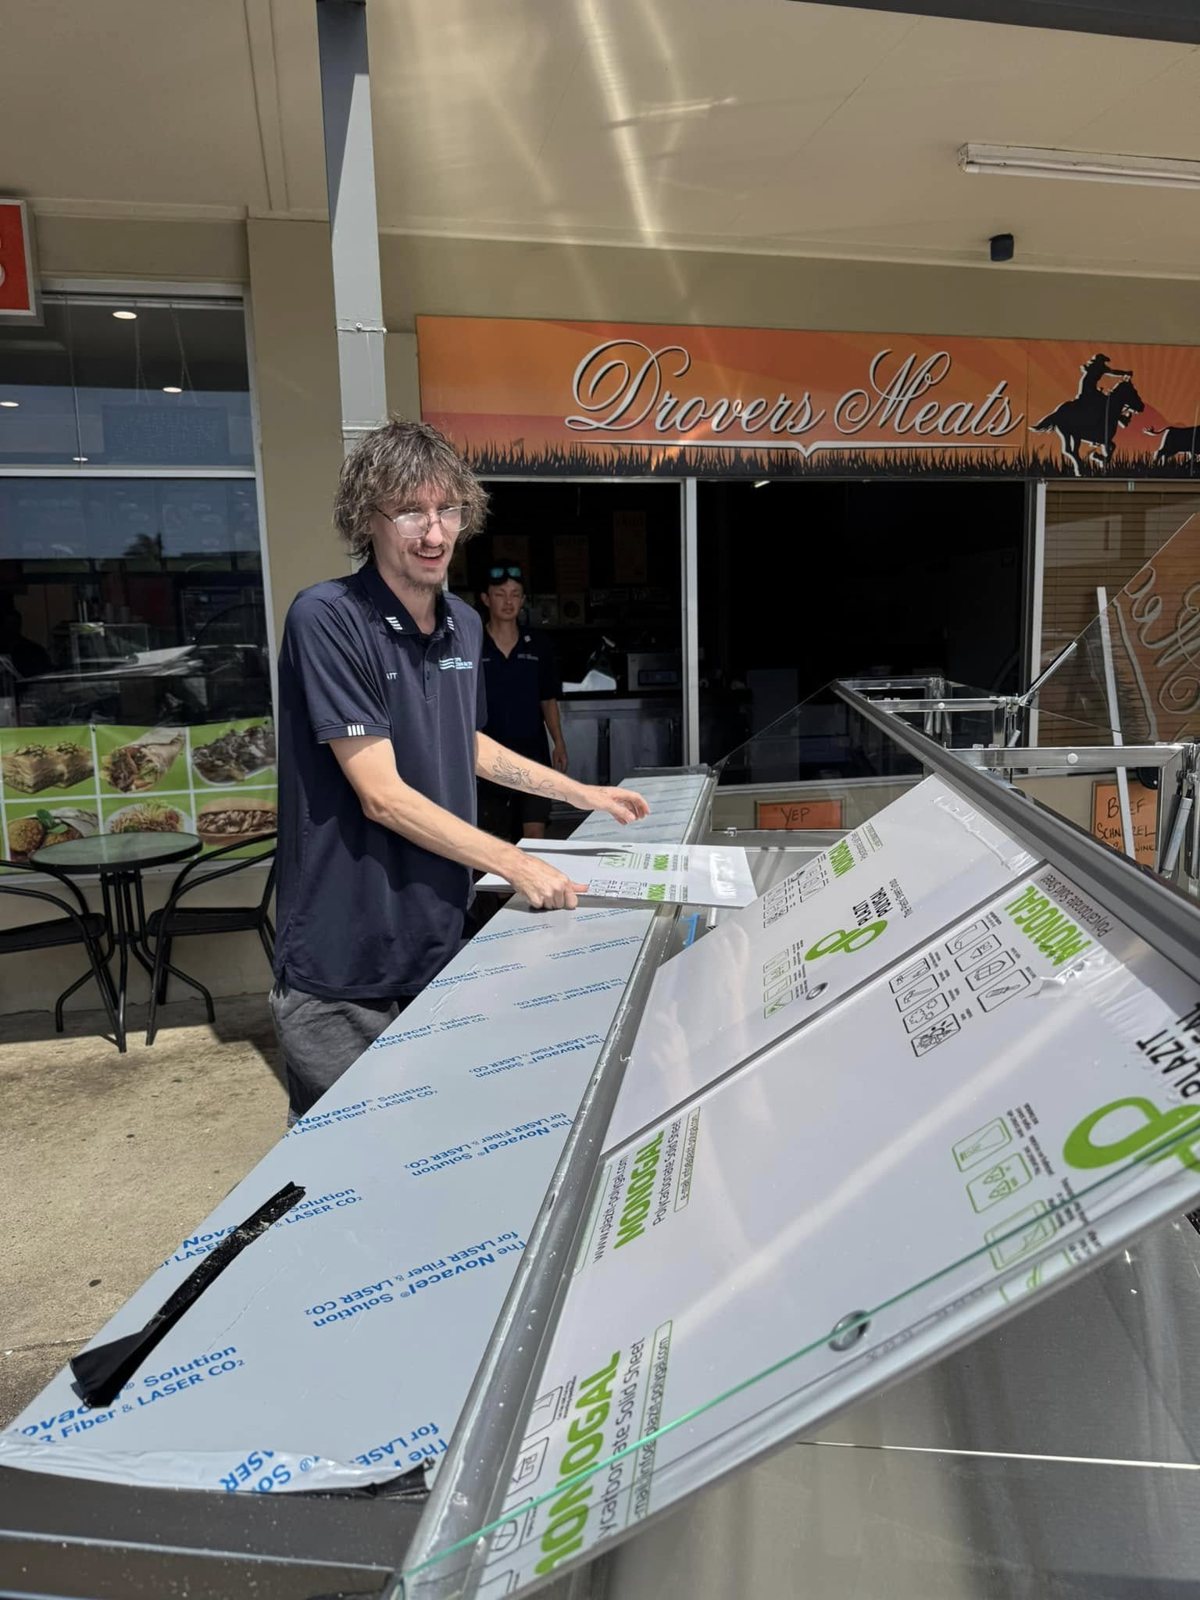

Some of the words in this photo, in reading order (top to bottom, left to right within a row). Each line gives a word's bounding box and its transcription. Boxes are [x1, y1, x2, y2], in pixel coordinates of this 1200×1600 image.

[565, 339, 824, 433] Drovers
[833, 349, 1024, 436] Meats
[781, 807, 810, 830] YEP
[1107, 797, 1146, 818] BEF
[1097, 822, 1156, 840] SCHNZEL
[1004, 885, 1092, 966] MONOGAL
[1066, 895, 1114, 937] Polycarbonate
[440, 1013, 484, 1026] Solution
[373, 1038, 408, 1050] LASER
[440, 1020, 470, 1031] LASER
[554, 1037, 584, 1048] LASER
[491, 1055, 522, 1068] LASER
[530, 1046, 554, 1056] Fiber
[476, 1063, 524, 1078] Solution
[377, 1084, 432, 1102] Solution
[293, 1119, 334, 1136] LASER
[336, 1109, 368, 1122] Fiber
[377, 1096, 416, 1109] LASER
[512, 1118, 550, 1134] LASER
[550, 1112, 568, 1121] for
[550, 1118, 575, 1129] The
[481, 1130, 512, 1144] Fiber
[411, 1152, 474, 1177] Solution
[430, 1143, 472, 1162] LASER
[613, 1130, 665, 1249] MONOGAL
[653, 1158, 675, 1226] Polycarbonate
[182, 1225, 239, 1249] Nova
[289, 1188, 356, 1214] Solution
[285, 1204, 334, 1224] LASER
[497, 1231, 519, 1243] for
[498, 1240, 527, 1256] The
[448, 1239, 498, 1263] LASER
[400, 1253, 496, 1298] Novacel®
[408, 1259, 447, 1278] Fiber
[339, 1279, 395, 1304] LASER
[313, 1293, 394, 1328] Solution
[143, 1346, 238, 1388] Solution
[623, 1336, 645, 1382] Sheet
[60, 1408, 118, 1438] Fiber
[122, 1404, 134, 1414] &
[137, 1373, 204, 1406] LASER
[615, 1382, 638, 1427] Solid
[410, 1422, 440, 1441] for
[351, 1436, 409, 1467] LASE
[408, 1438, 449, 1463] The
[219, 1450, 274, 1494] SER
